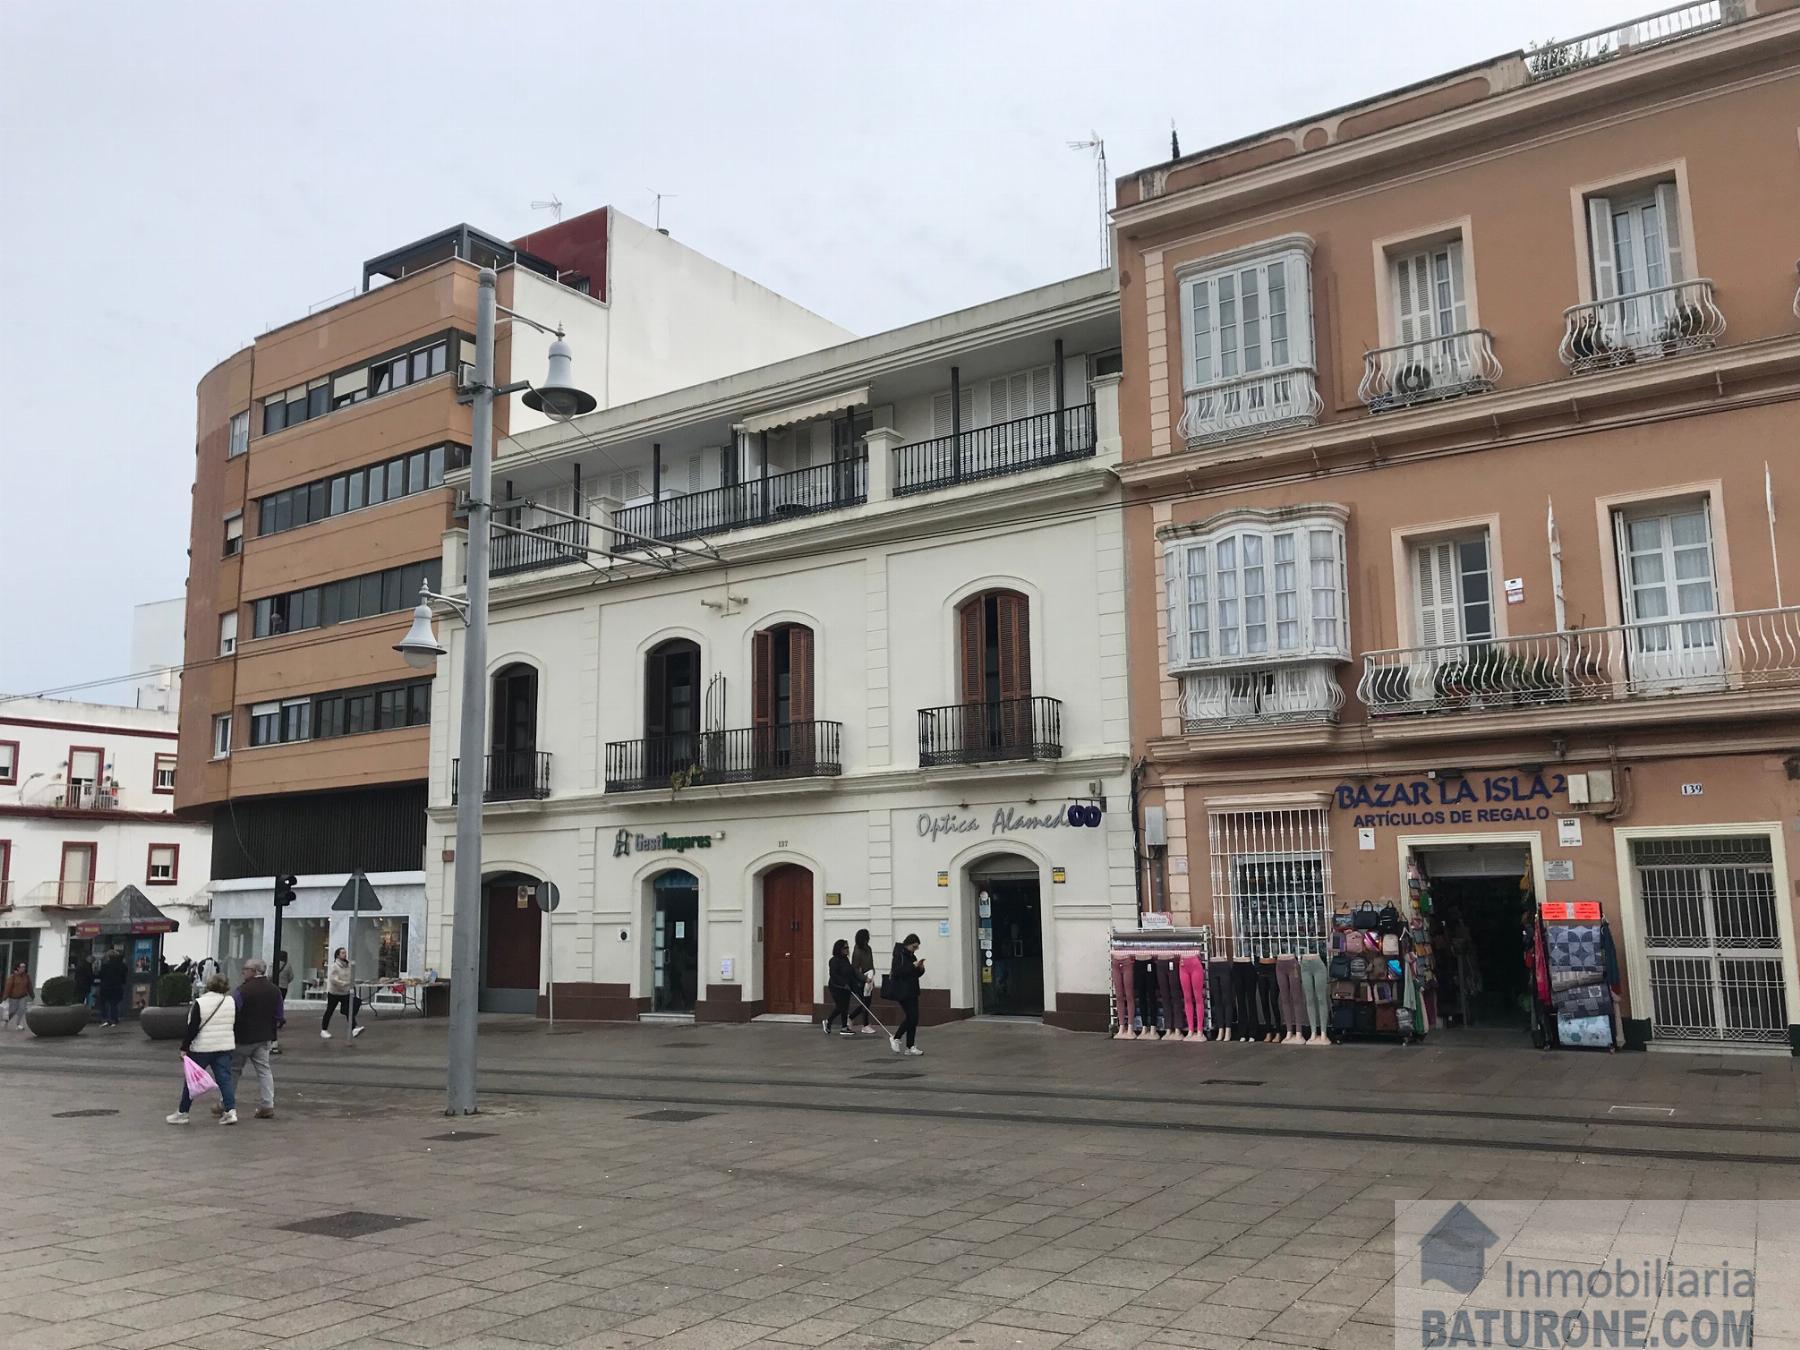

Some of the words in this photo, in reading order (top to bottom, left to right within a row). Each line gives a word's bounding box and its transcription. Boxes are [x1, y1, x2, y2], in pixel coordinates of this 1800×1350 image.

[1335, 781, 1432, 809] BAZAR
[1439, 779, 1479, 804] LA
[1483, 775, 1553, 802] ISLA
[1551, 773, 1568, 793] 2
[1683, 784, 1702, 794] 139
[917, 813, 980, 843] Optica
[1353, 811, 1446, 827] ARTÍCULOS
[1450, 810, 1473, 824] DE
[1477, 806, 1550, 822] REGALO
